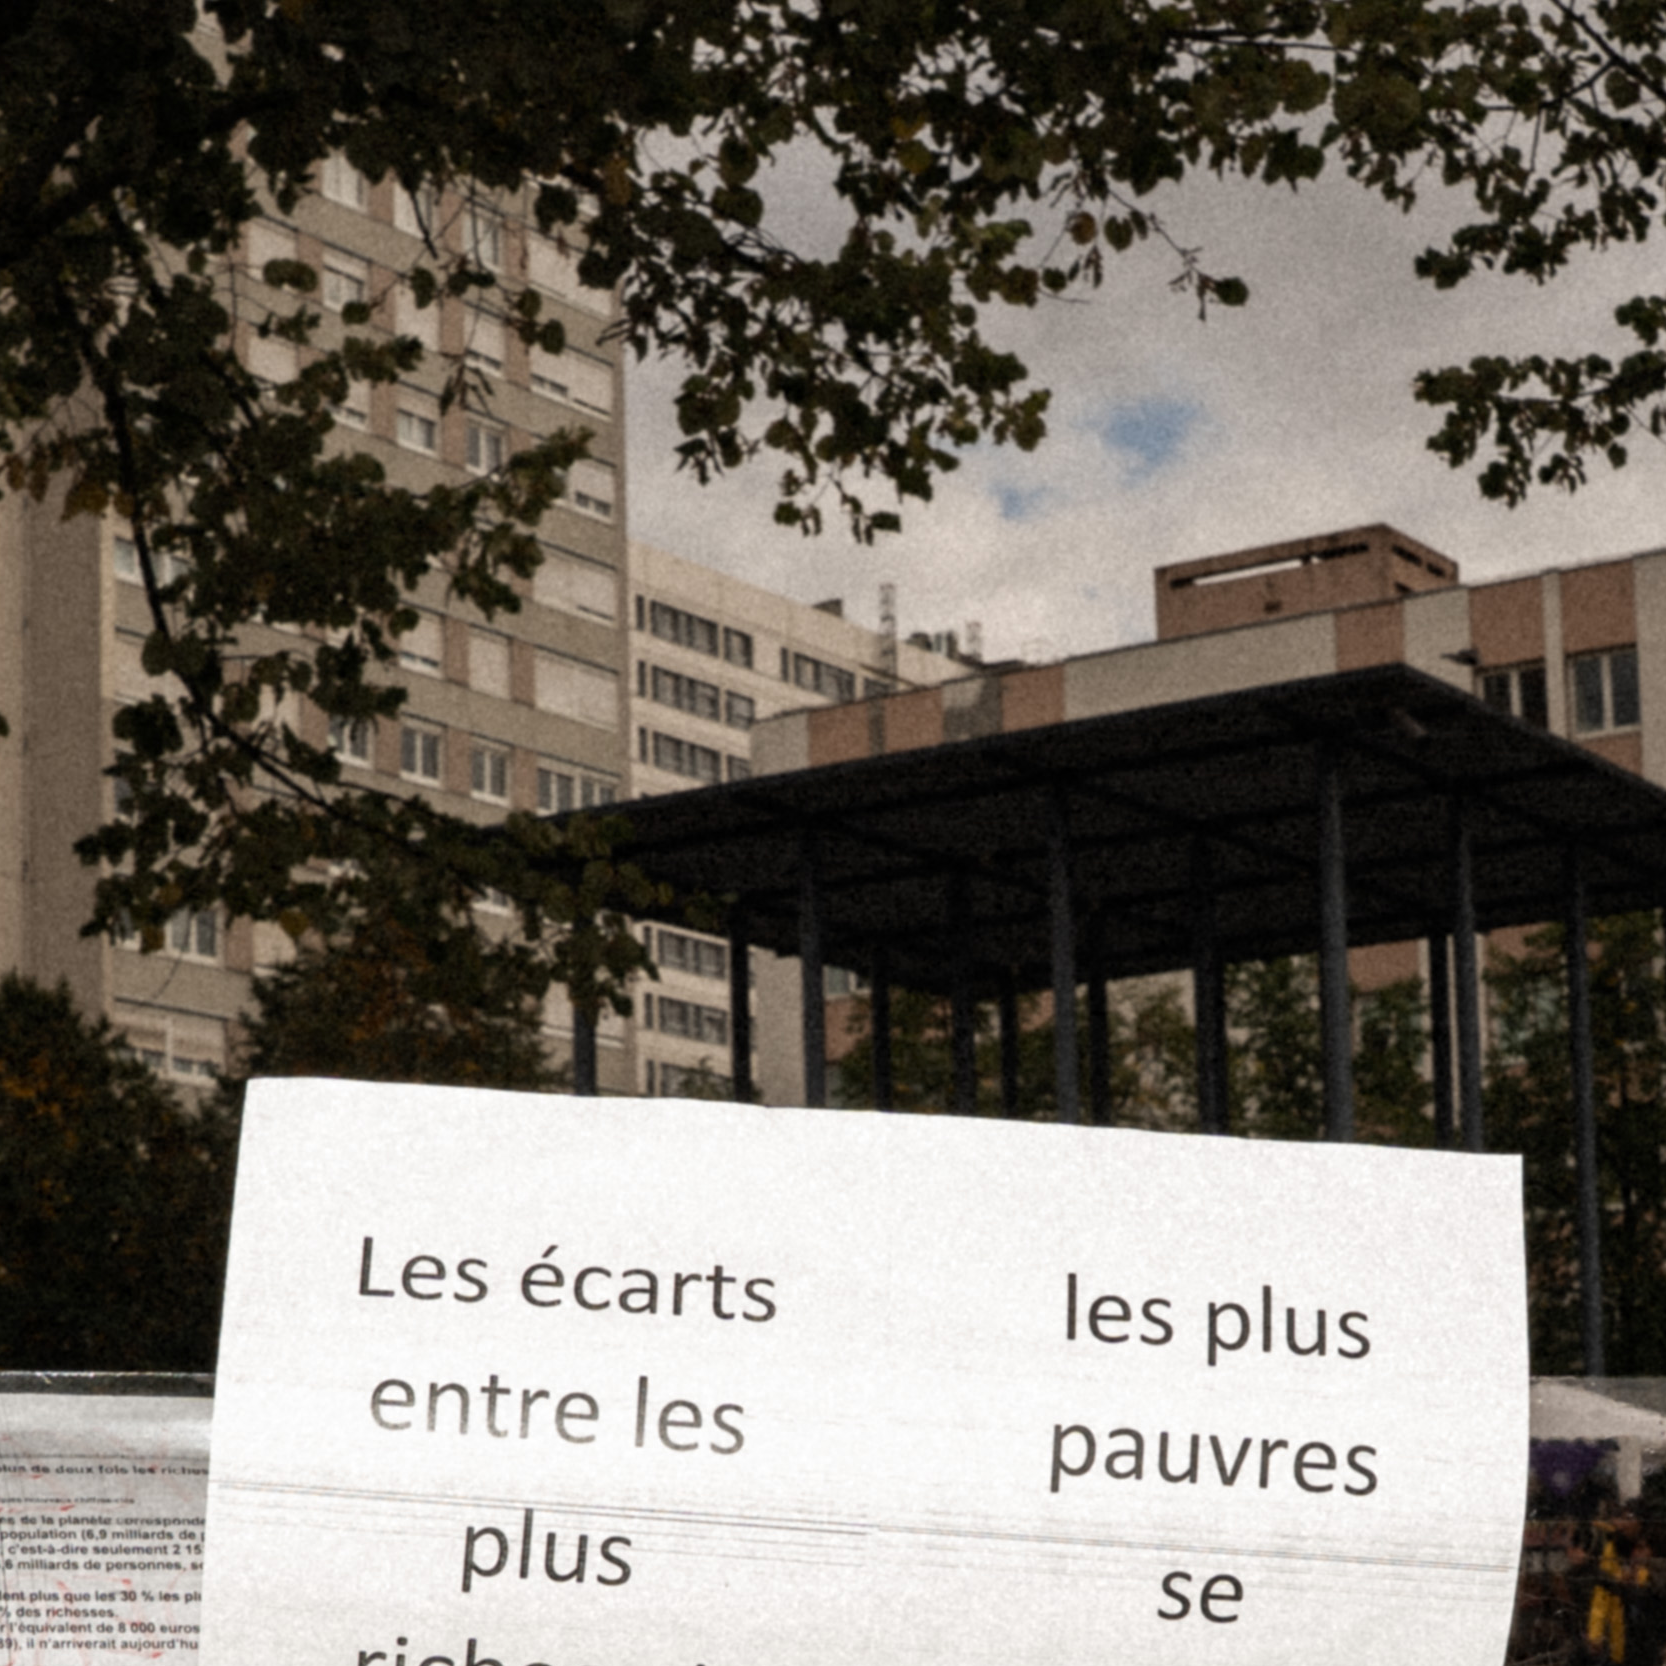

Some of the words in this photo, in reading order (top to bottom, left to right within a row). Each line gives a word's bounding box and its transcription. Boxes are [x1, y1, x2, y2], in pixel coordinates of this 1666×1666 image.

[359, 1237, 487, 1302] Les
[522, 1245, 775, 1322] écarts
[1067, 1273, 1173, 1345] les
[1208, 1286, 1370, 1366] plus
[371, 1375, 598, 1442] entre
[636, 1376, 743, 1454] les
[1051, 1425, 1377, 1496] pauvres
[8, 1542, 89, 1555] c'est-à-dire
[92, 1542, 168, 1555] seulement
[173, 1542, 181, 1555] 2
[462, 1508, 631, 1592] plus
[16, 1604, 41, 1617] des
[46, 1605, 118, 1618] richesses.
[29, 1588, 60, 1604] plus
[63, 1592, 91, 1604] que
[94, 1589, 114, 1602] les
[120, 1589, 138, 1602] 30
[141, 1589, 156, 1602] %
[158, 1589, 181, 1602] les
[1158, 1572, 1243, 1623] se
[26, 1636, 35, 1649] il
[39, 1637, 116, 1650] n'arriverait
[96, 1620, 114, 1633] de
[118, 1620, 127, 1633] 8
[130, 1620, 156, 1633] 000
[159, 1623, 200, 1633] euros
